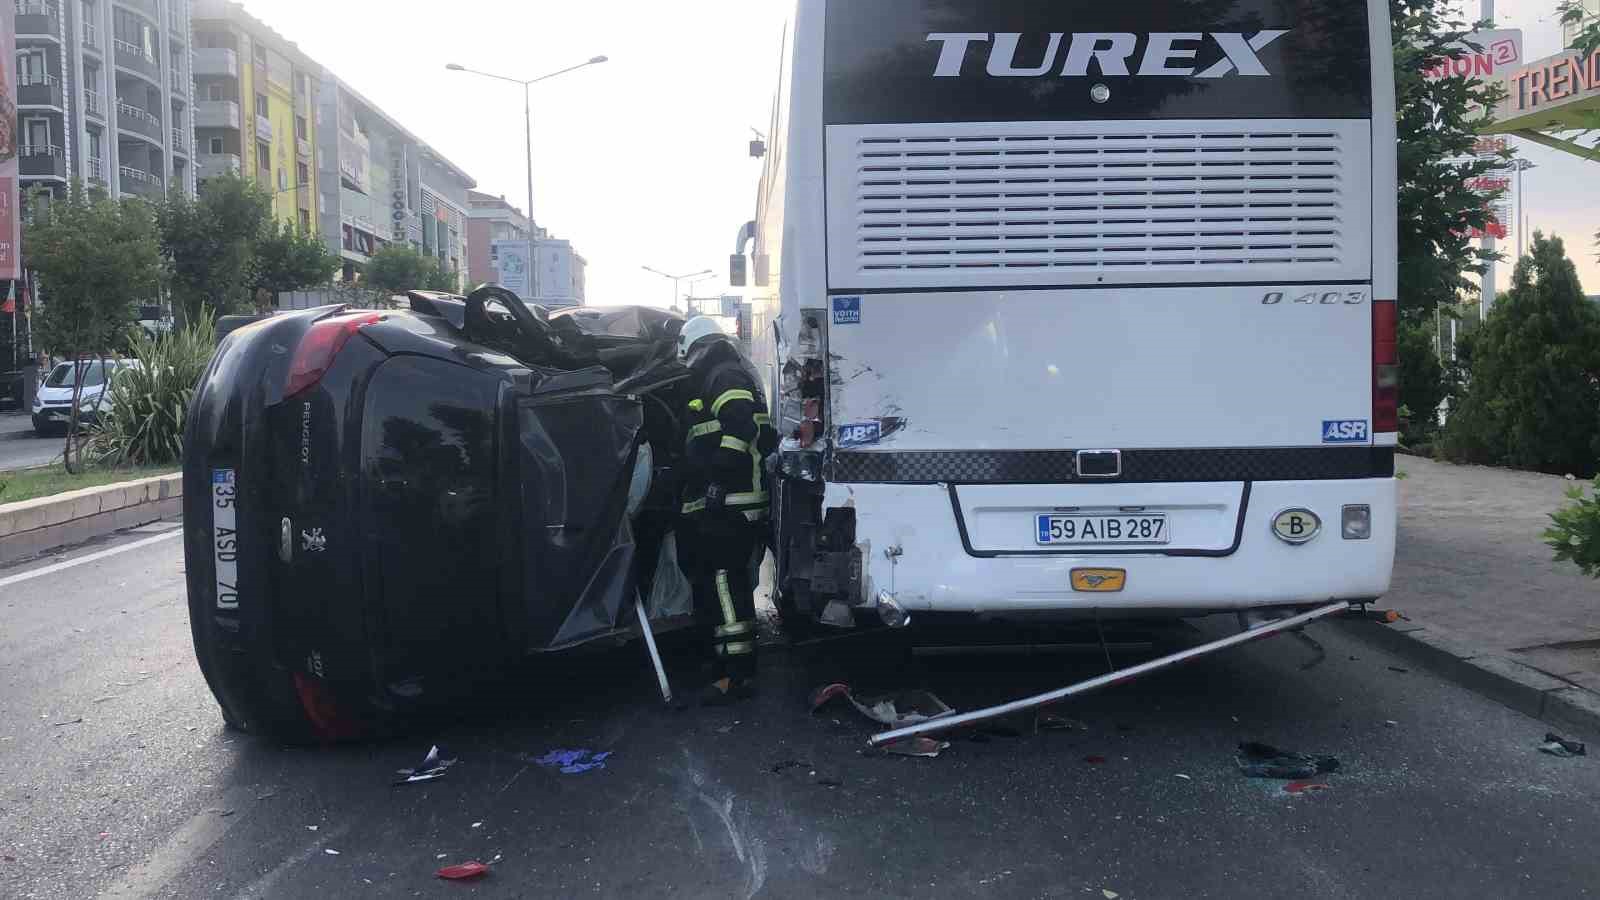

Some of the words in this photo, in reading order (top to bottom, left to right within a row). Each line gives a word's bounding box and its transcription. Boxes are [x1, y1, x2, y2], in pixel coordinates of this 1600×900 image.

[926, 30, 1291, 77] TUREX
[1497, 46, 1510, 58] 2
[1294, 292, 1366, 304] 403
[302, 402, 311, 464] PEUGEOT
[1326, 422, 1366, 439] ASR
[216, 486, 235, 508] 35
[1050, 519, 1076, 539] 59
[1081, 519, 1122, 539] AIB
[1127, 518, 1165, 539] 287
[1291, 516, 1304, 534] B
[216, 527, 237, 562] ASD
[219, 582, 239, 603] 70
